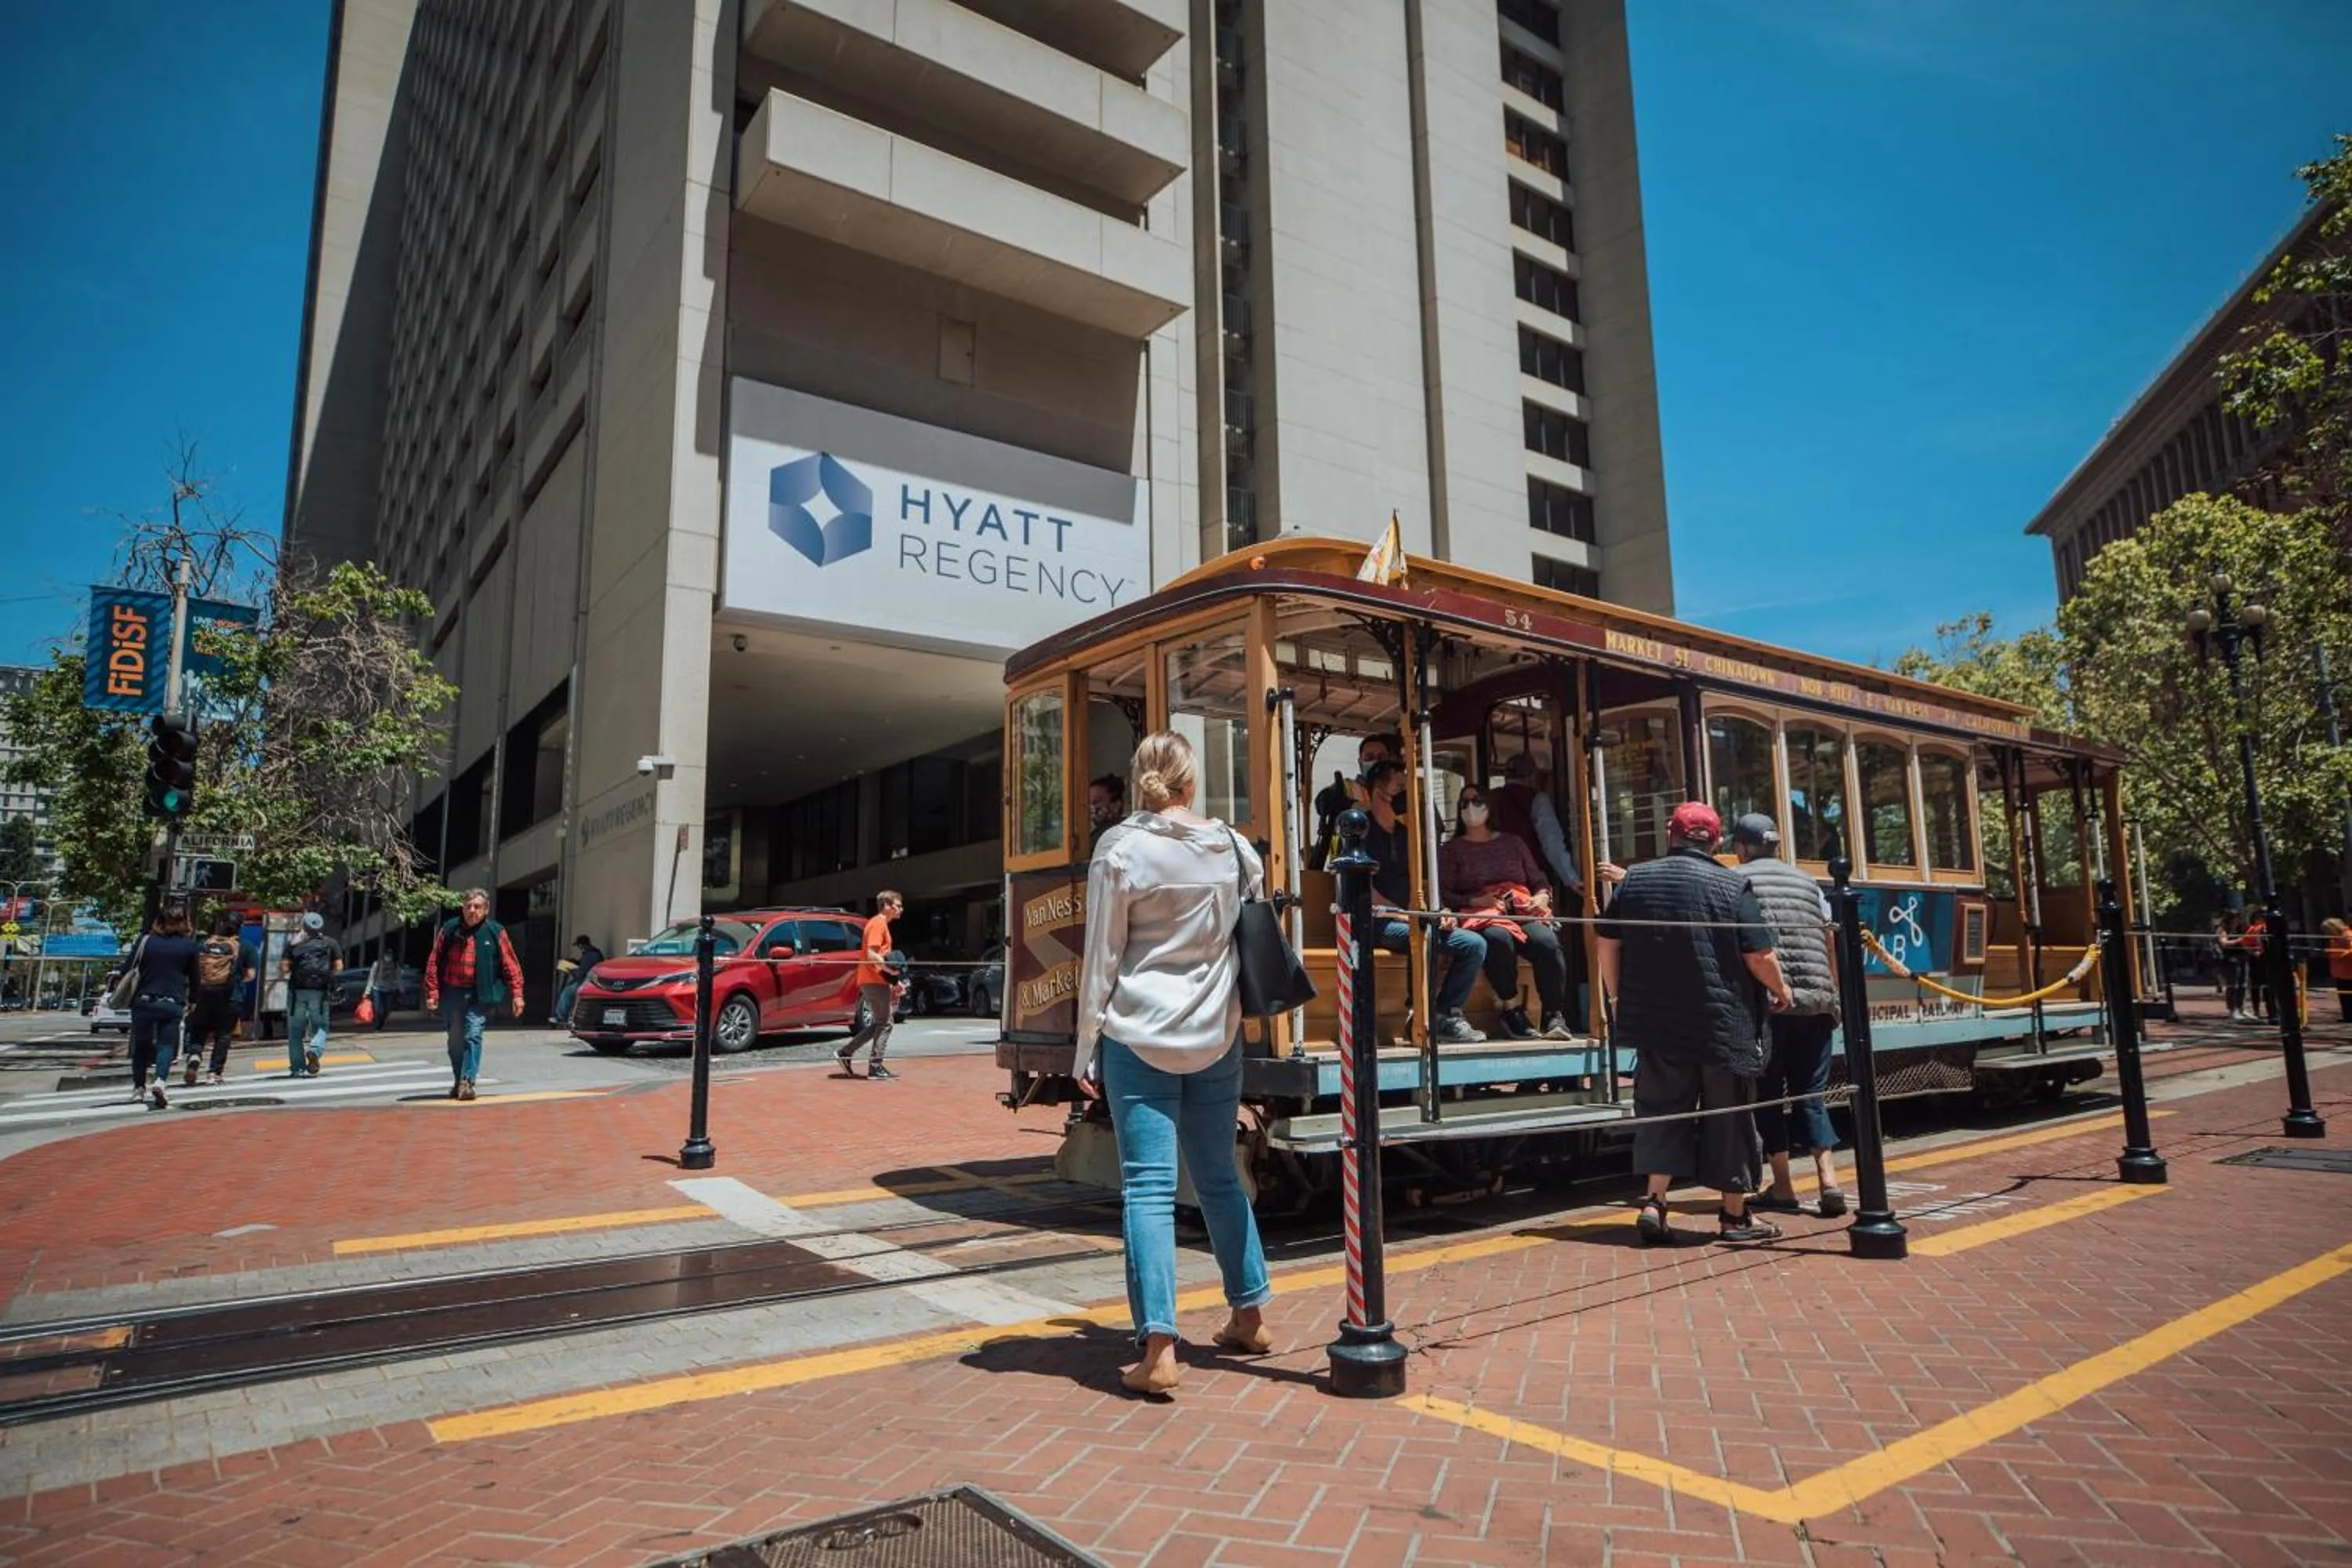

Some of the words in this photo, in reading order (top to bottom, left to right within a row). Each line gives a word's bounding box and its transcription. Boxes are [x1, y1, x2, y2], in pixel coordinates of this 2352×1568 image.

[900, 484, 1073, 552] HYATT
[899, 533, 1125, 607] REGENCY
[1504, 608, 1533, 630] 54
[107, 604, 148, 696] FiDiSF
[1606, 630, 1663, 661] MARKET
[1705, 656, 1775, 686] CHINATOWN
[181, 835, 253, 848] ALIFORNIA
[1026, 905, 1046, 928] Van
[1047, 895, 1082, 923] Ness
[1032, 965, 1080, 1006] Market
[1869, 1004, 1911, 1021] ICIPAL
